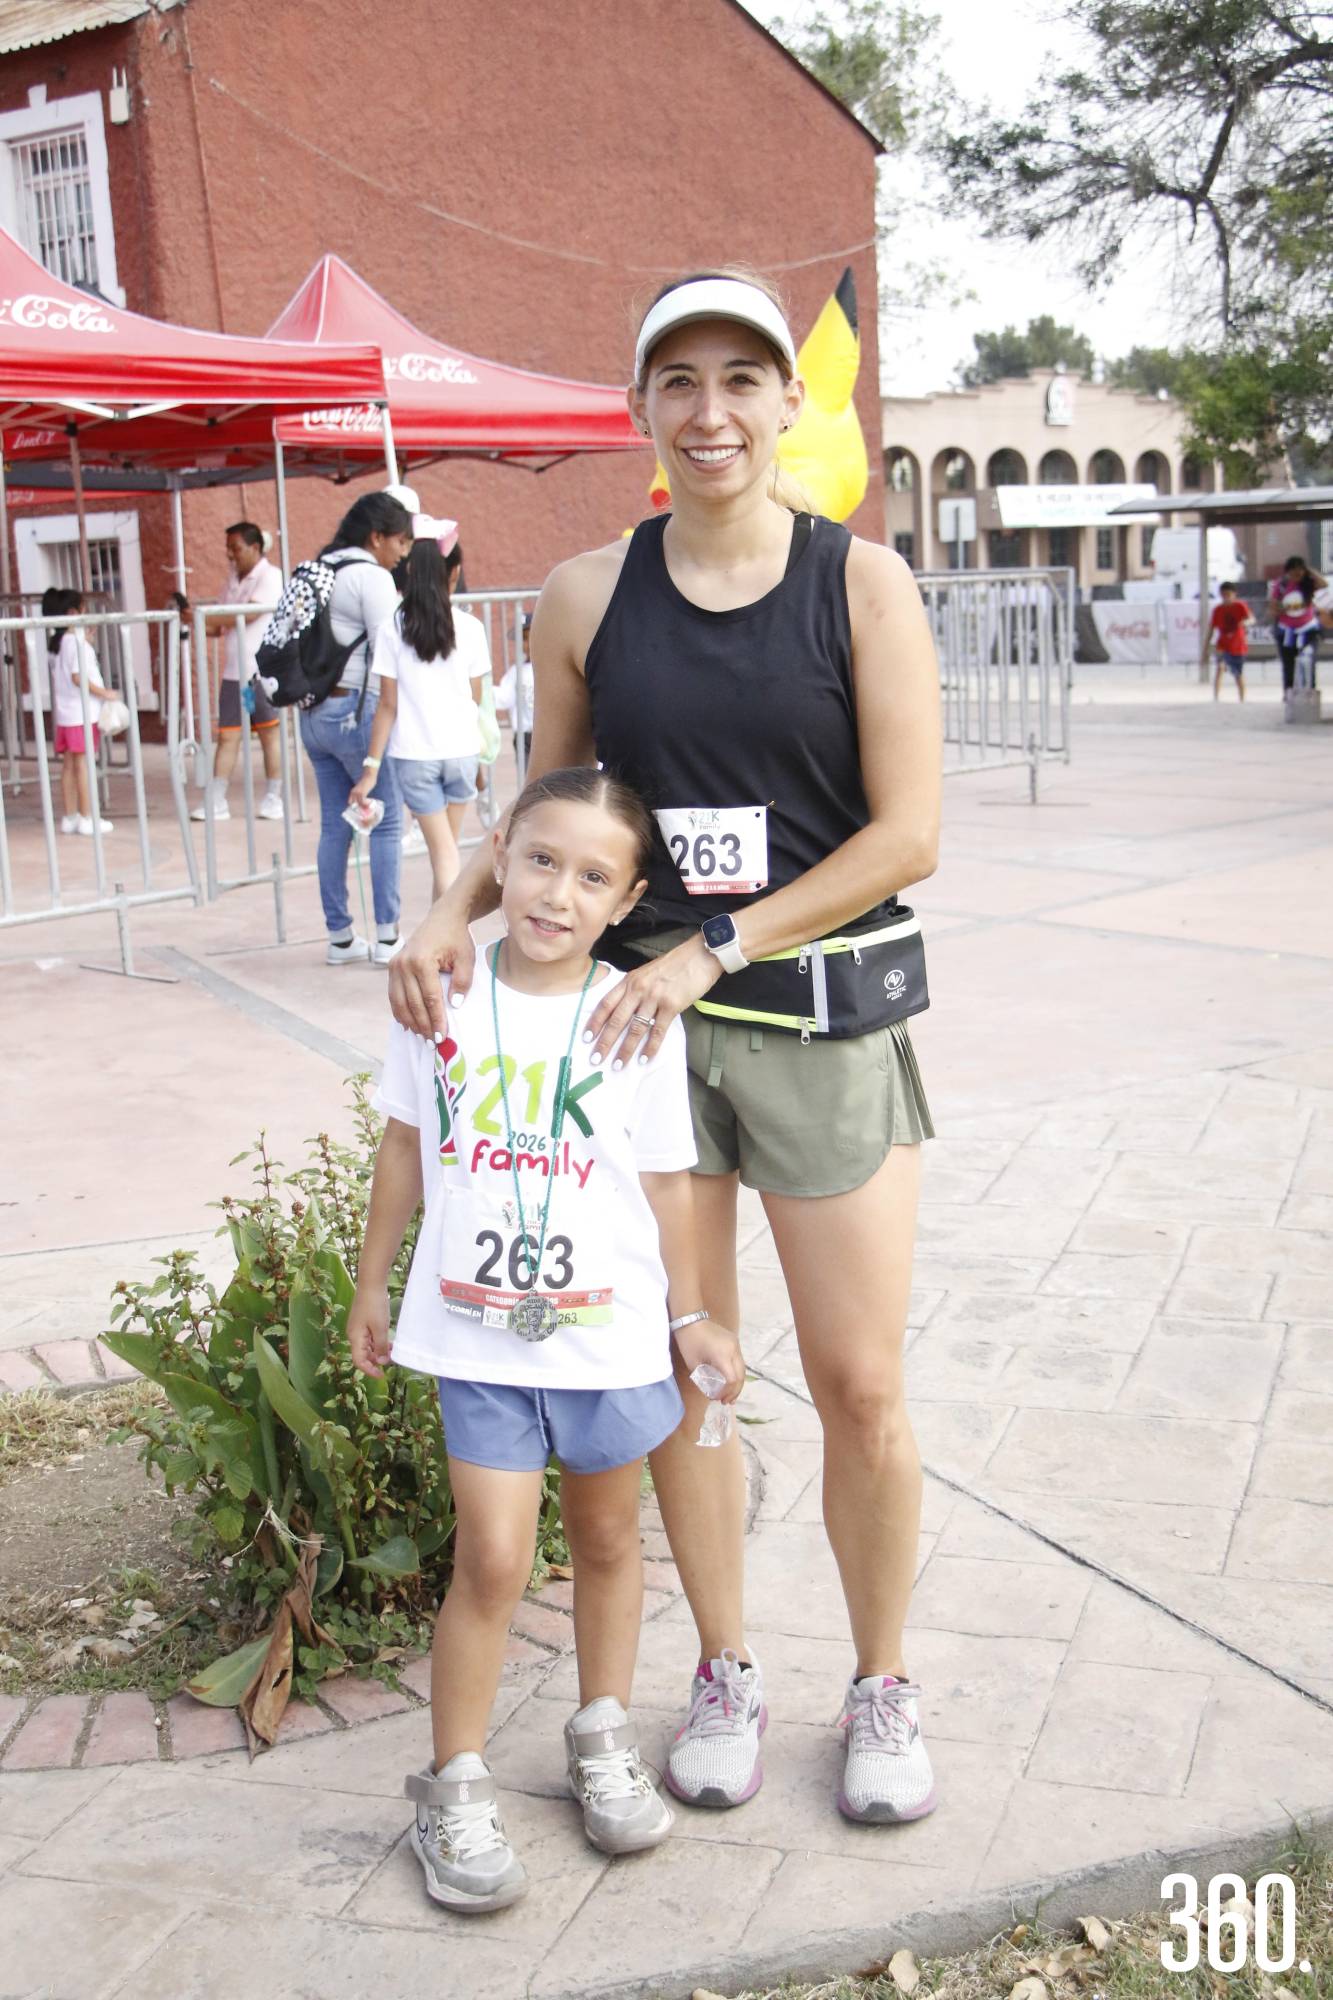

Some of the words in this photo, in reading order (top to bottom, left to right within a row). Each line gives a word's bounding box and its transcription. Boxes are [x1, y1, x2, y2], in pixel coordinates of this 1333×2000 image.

[669, 833, 743, 877] 263
[471, 1055, 603, 1139] 21K
[471, 1139, 594, 1189] family
[474, 1229, 574, 1291] 263
[558, 1312, 578, 1325] 263
